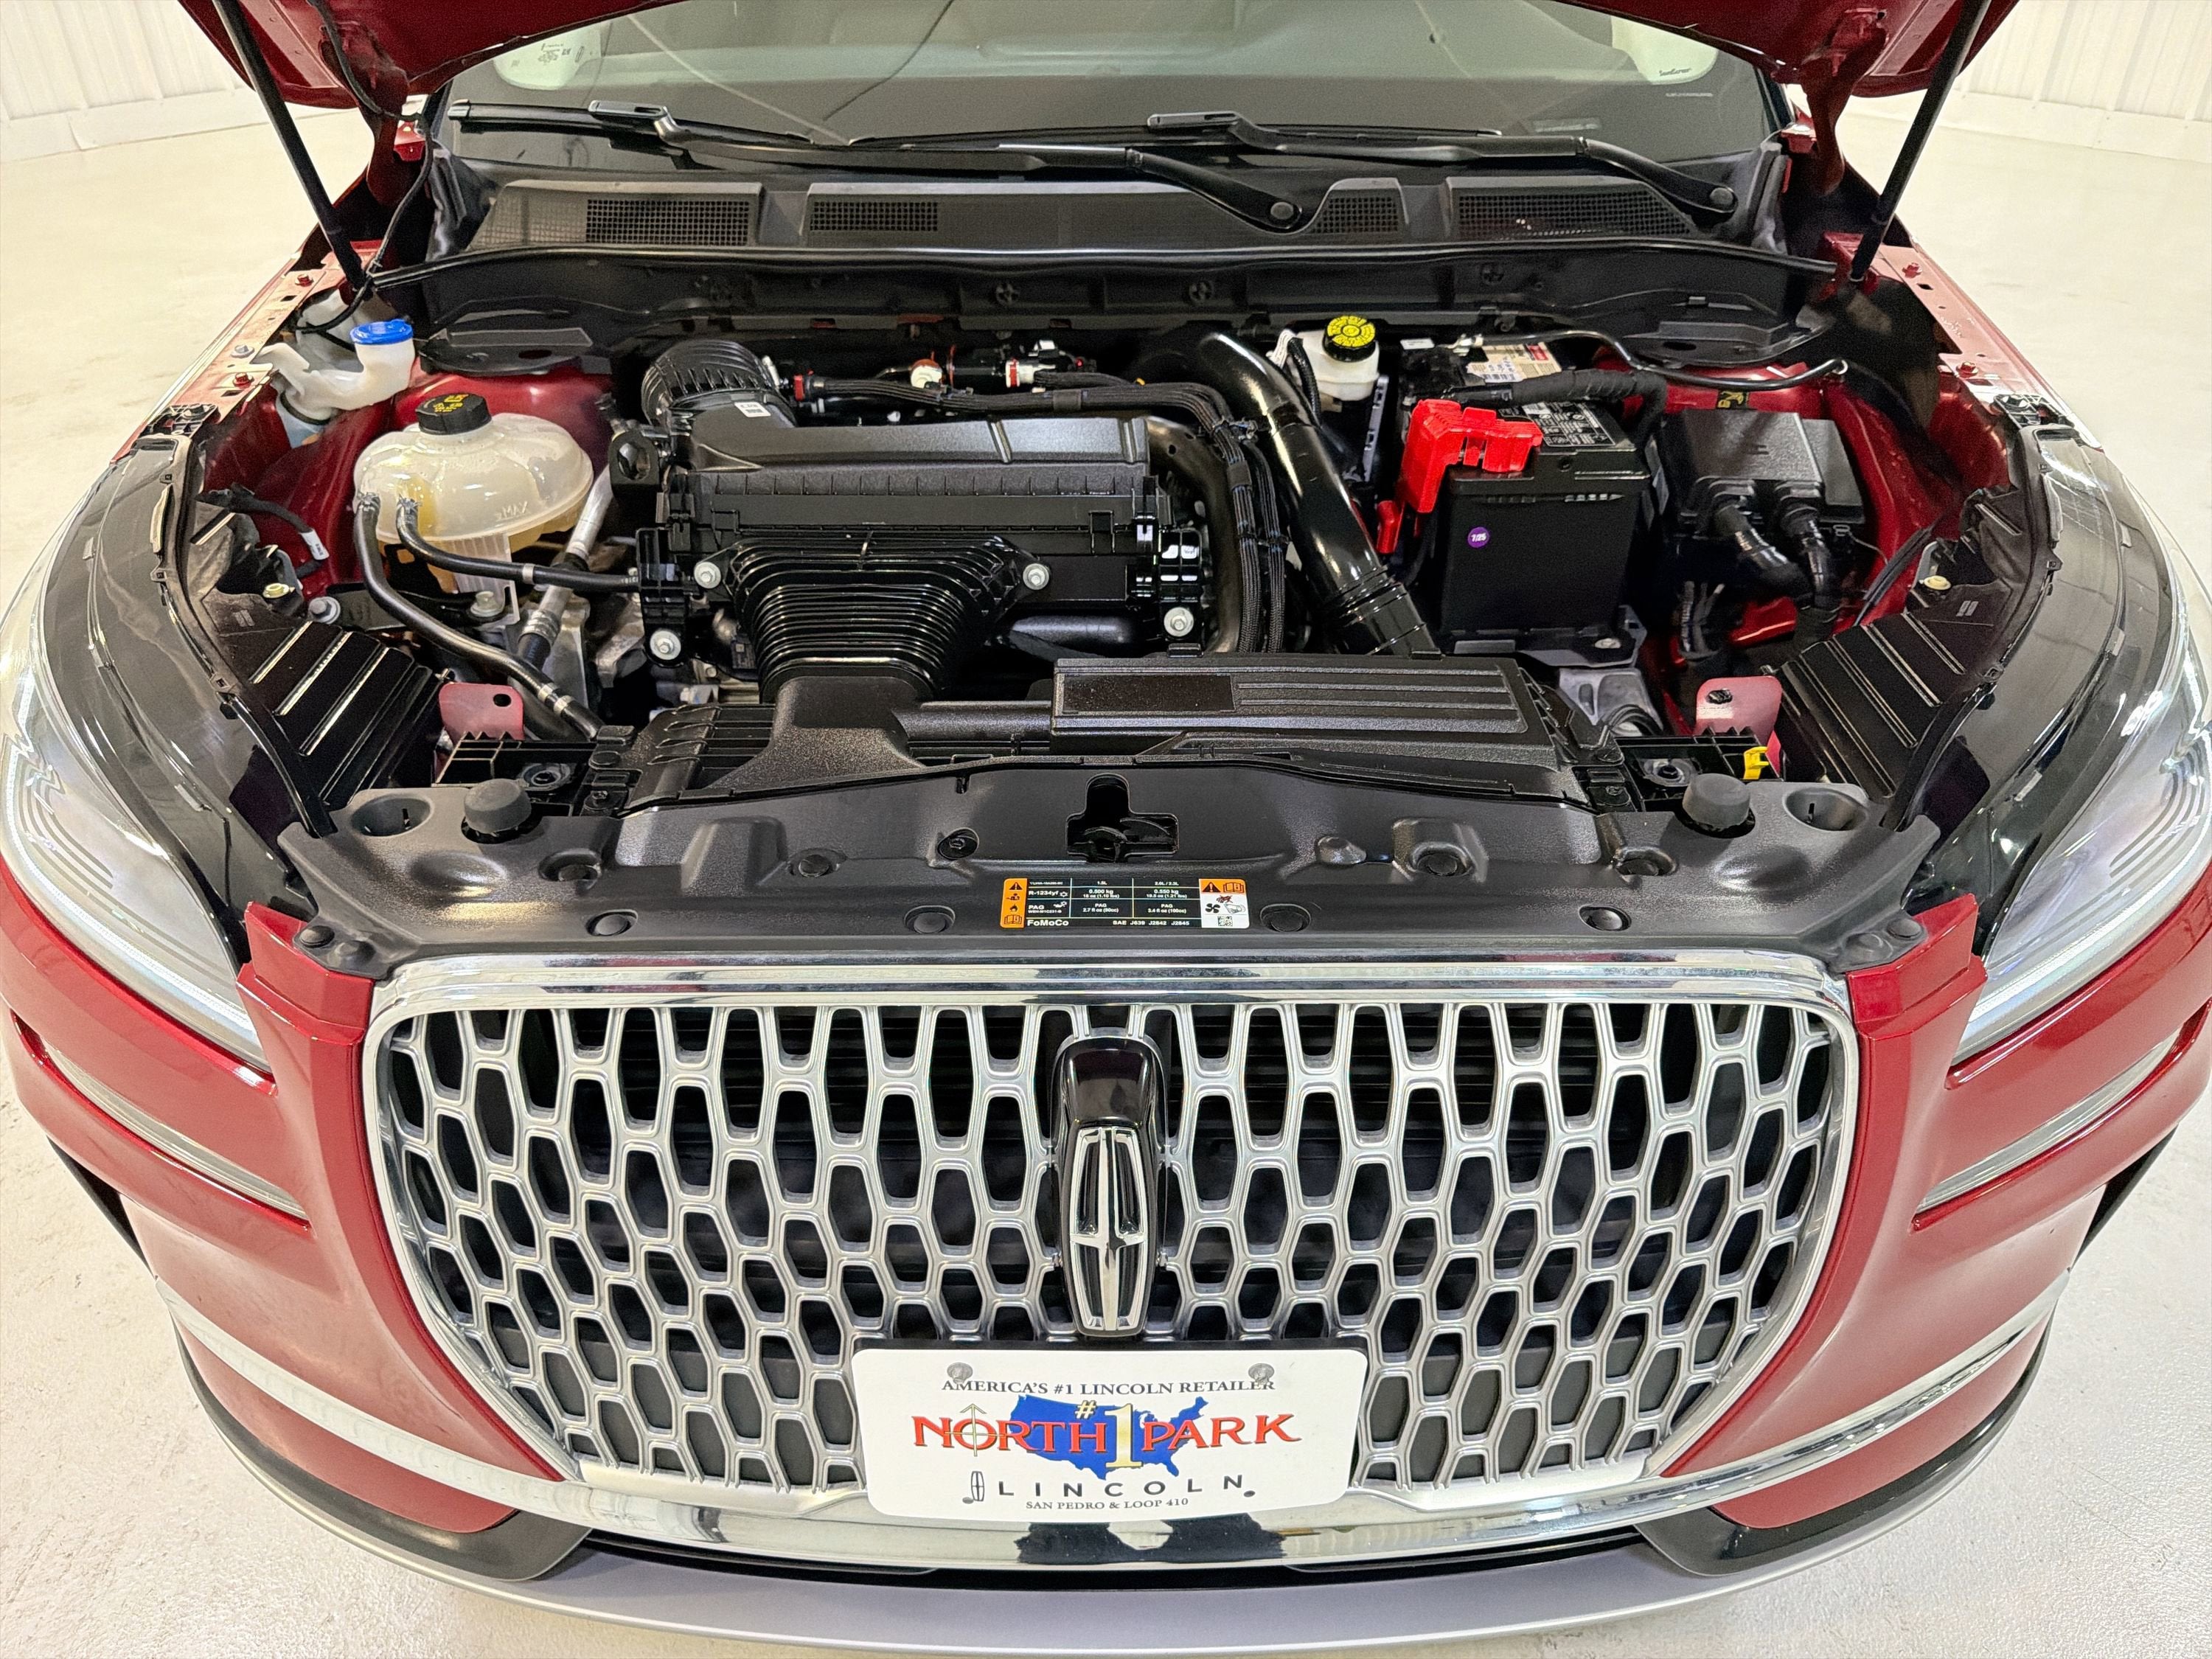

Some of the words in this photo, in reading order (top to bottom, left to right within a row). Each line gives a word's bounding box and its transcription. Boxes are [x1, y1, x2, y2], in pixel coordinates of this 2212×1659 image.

[942, 1380, 1048, 1394] AMERICA'S
[1054, 1384, 1074, 1394] #1
[1080, 1382, 1174, 1395] LINCOLN
[1180, 1380, 1276, 1394] RETAILER
[911, 1415, 1107, 1454] NORTH
[1141, 1413, 1303, 1452] PARK
[998, 1474, 1243, 1498] LINCOLN
[1026, 1501, 1053, 1509] SAN
[1057, 1501, 1105, 1510] PEDRO
[1124, 1499, 1163, 1509] LOOP
[1166, 1498, 1189, 1506] 410
